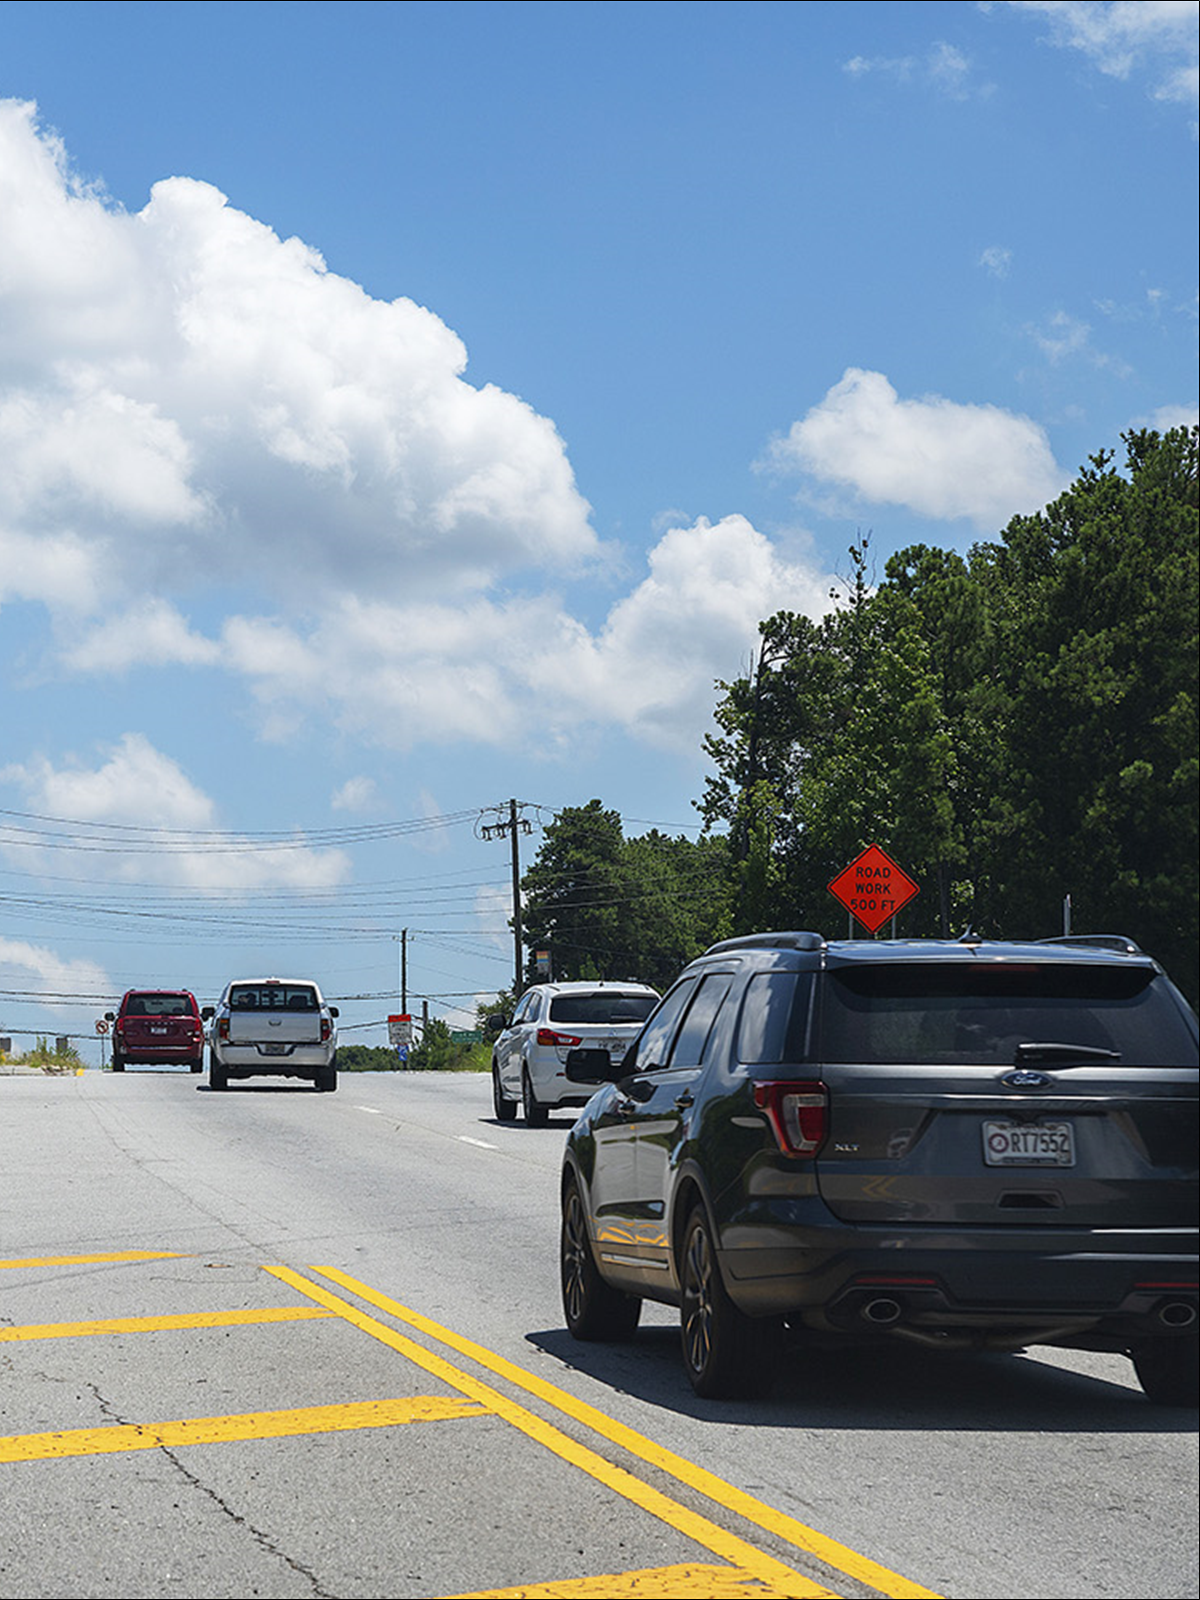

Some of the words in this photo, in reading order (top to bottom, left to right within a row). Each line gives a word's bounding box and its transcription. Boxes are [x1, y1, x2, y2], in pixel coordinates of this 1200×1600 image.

[855, 866, 892, 879] ROAD
[855, 883, 892, 895] WORK
[850, 899, 877, 911] 500
[881, 900, 896, 911] FT
[1012, 1074, 1042, 1085] Ford
